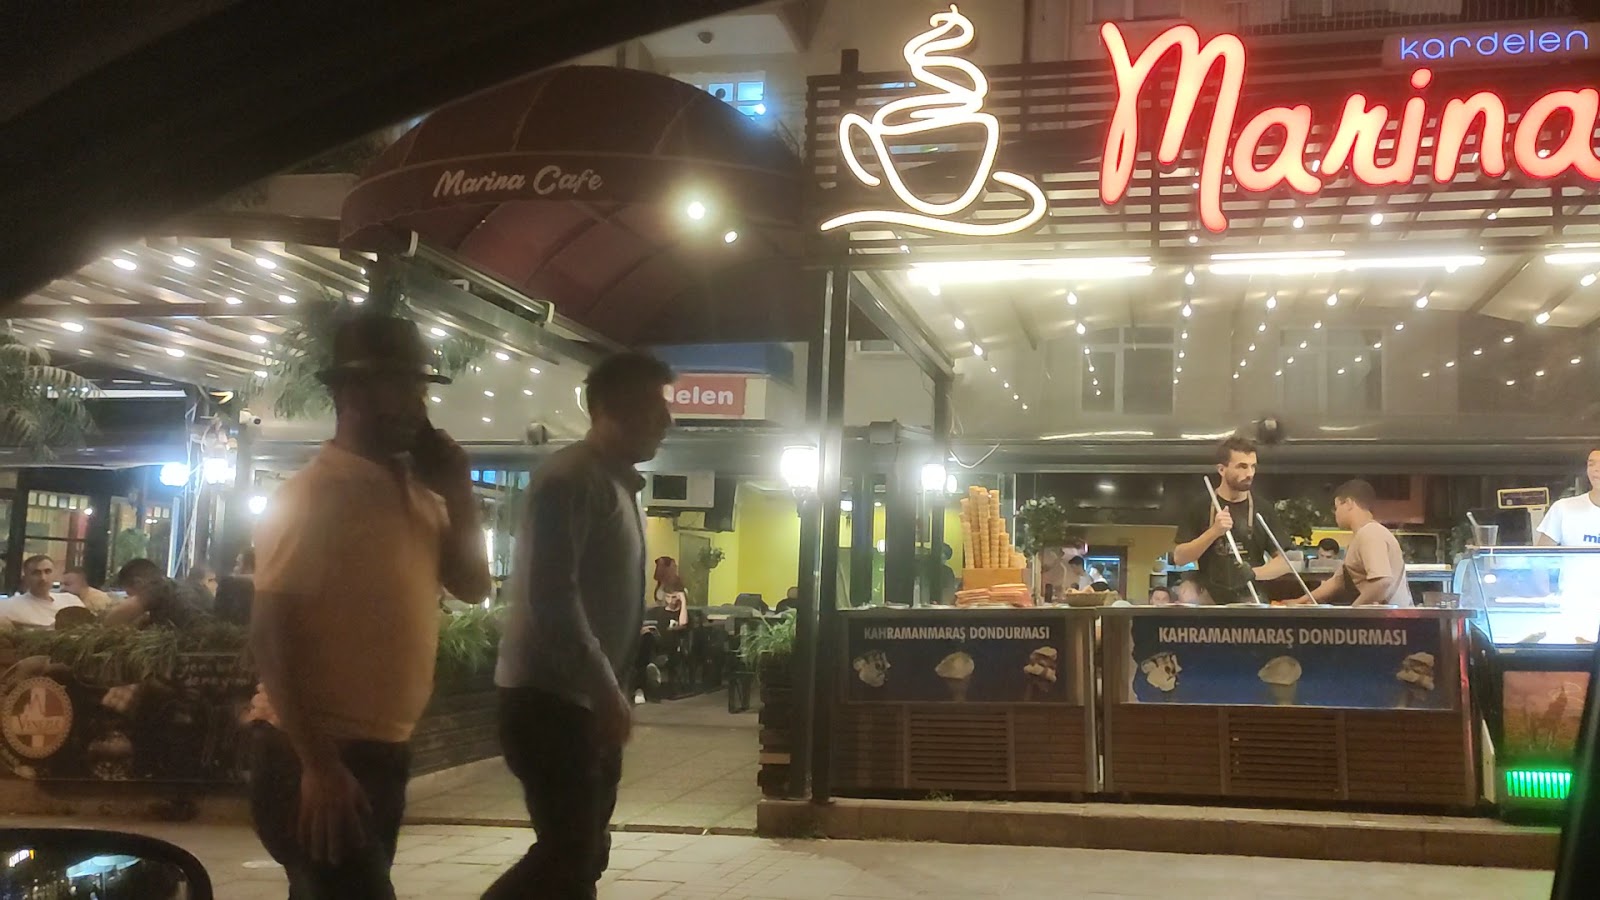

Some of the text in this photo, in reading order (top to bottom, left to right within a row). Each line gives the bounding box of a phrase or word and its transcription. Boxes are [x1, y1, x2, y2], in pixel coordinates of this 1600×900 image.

[1400, 29, 1589, 60] kardelen
[1100, 21, 1600, 232] Marina
[433, 165, 603, 198] Marina Cafe
[864, 626, 1050, 643] KAHRAMANMARAŞ DONDURMASI
[1158, 627, 1407, 649] KAHRAMANMARAŞ DONDURMASI
